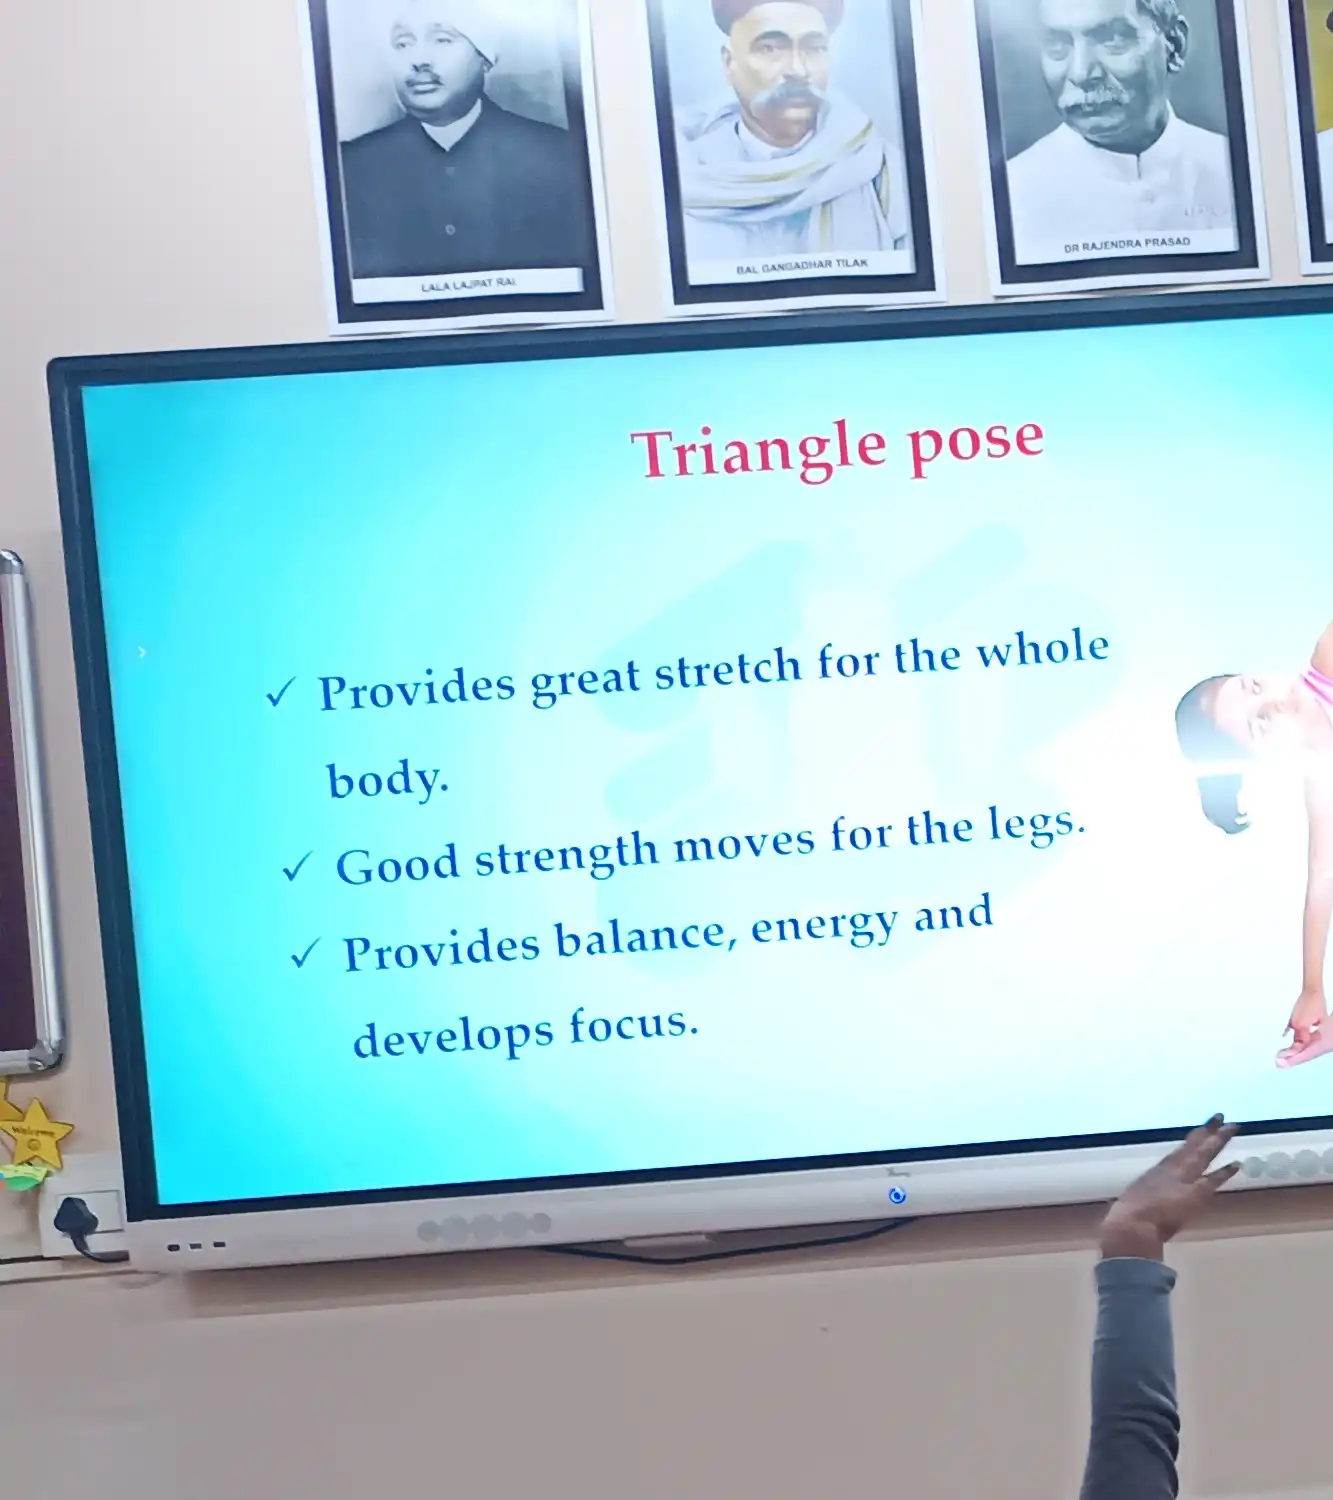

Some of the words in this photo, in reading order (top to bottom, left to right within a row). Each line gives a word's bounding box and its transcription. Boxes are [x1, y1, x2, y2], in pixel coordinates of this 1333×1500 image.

[736, 266, 758, 275] BAL
[762, 260, 832, 273] GANGADHAR
[835, 259, 868, 268] TILAK
[1064, 244, 1079, 253] DR
[1082, 240, 1142, 251] RAJENDRA
[1145, 237, 1191, 247] PRASAD
[421, 282, 451, 292] LALA
[453, 279, 492, 291] LAJPAT
[496, 277, 516, 287] RAI
[630, 418, 886, 486] Triangle
[907, 423, 1045, 479] pose
[318, 667, 515, 711] Provides
[531, 660, 640, 709] great
[655, 647, 803, 689] stretch
[818, 643, 880, 678] for
[895, 638, 961, 673] the
[976, 627, 1110, 667] whole
[326, 759, 448, 805] body.
[336, 843, 460, 885] Good
[475, 830, 660, 880] strength
[674, 828, 815, 862] moves
[831, 816, 893, 852] for
[907, 810, 973, 846] the
[988, 805, 1086, 849] legs.
[342, 928, 540, 972] Provides
[554, 918, 737, 957] balance,
[751, 911, 899, 948] energy
[915, 892, 993, 931] and
[353, 1016, 553, 1061] develops
[570, 1007, 698, 1044] focus.
